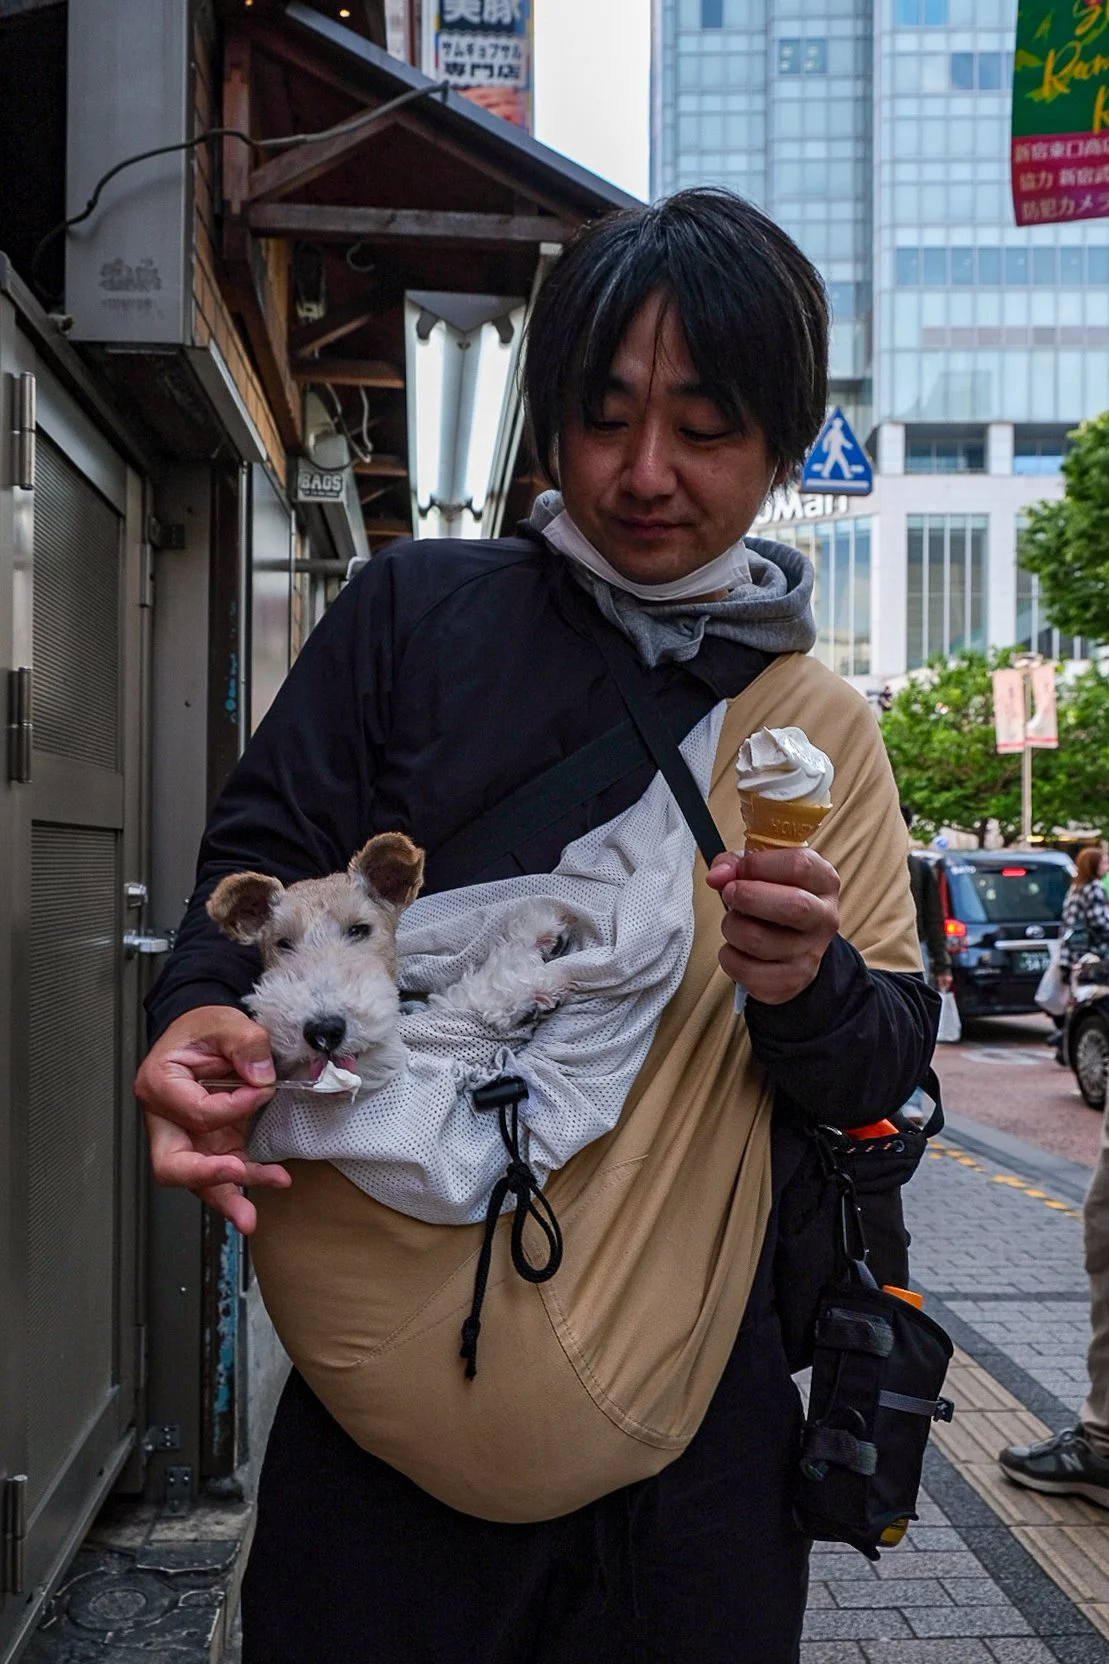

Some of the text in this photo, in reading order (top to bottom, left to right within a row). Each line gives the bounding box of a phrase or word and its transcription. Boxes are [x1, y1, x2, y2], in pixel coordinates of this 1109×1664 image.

[444, 62, 520, 79] 専門店
[300, 473, 342, 491] BAGS
[1060, 1453, 1084, 1472] N
